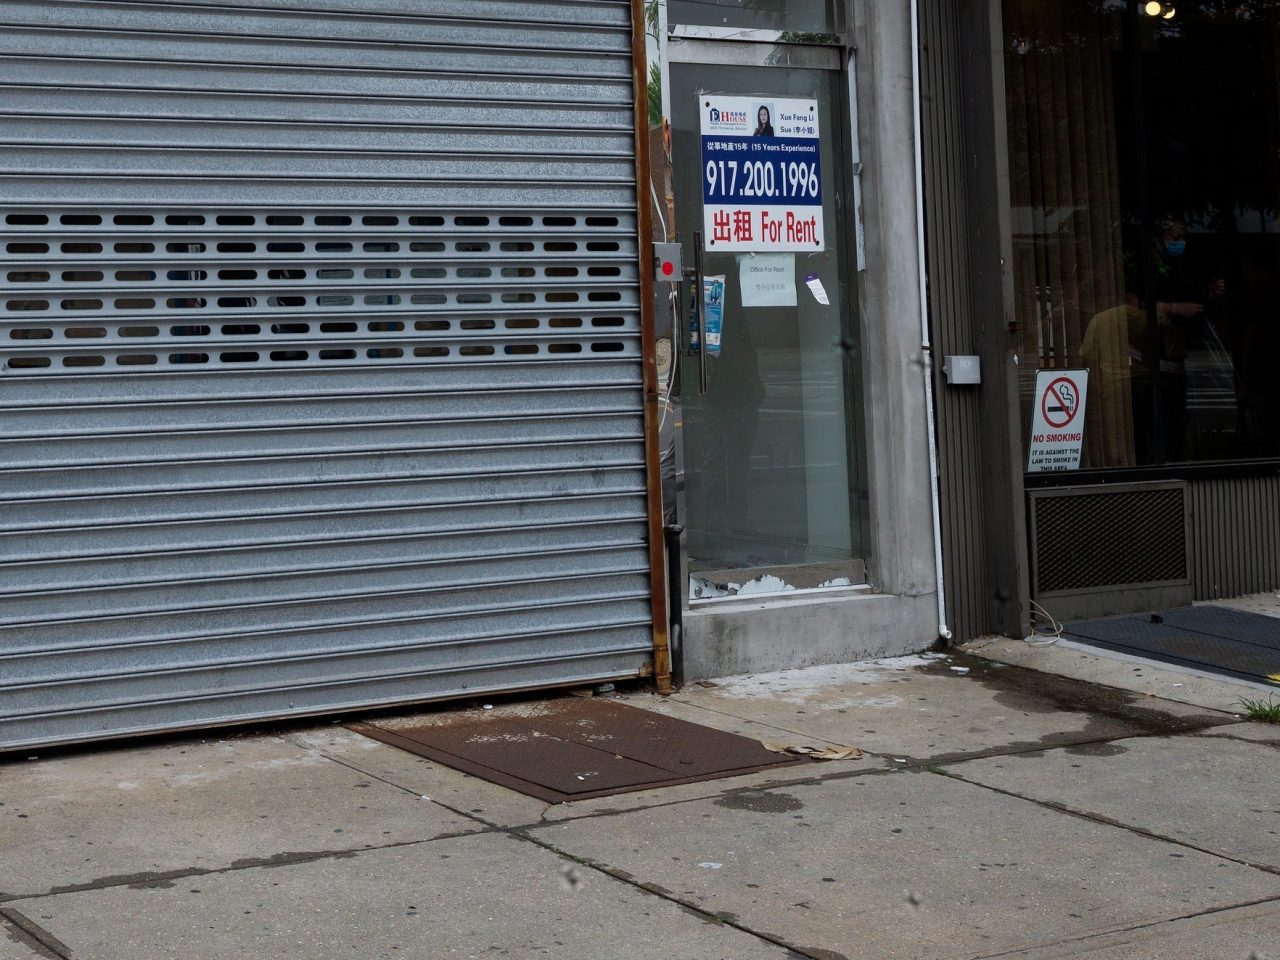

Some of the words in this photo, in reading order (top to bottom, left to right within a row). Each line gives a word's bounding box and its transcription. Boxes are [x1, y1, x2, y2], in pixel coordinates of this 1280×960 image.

[780, 113, 792, 121] Xue
[793, 114, 807, 122] Fang
[780, 126, 792, 134] Sue
[763, 143, 780, 151] Years
[781, 144, 816, 153] Experience)
[706, 160, 819, 198] 917.200.1996
[713, 209, 754, 243] 出租
[761, 211, 783, 243] For
[786, 211, 817, 243] Rent
[1032, 434, 1044, 443] NO
[1046, 433, 1081, 443] SMOKING
